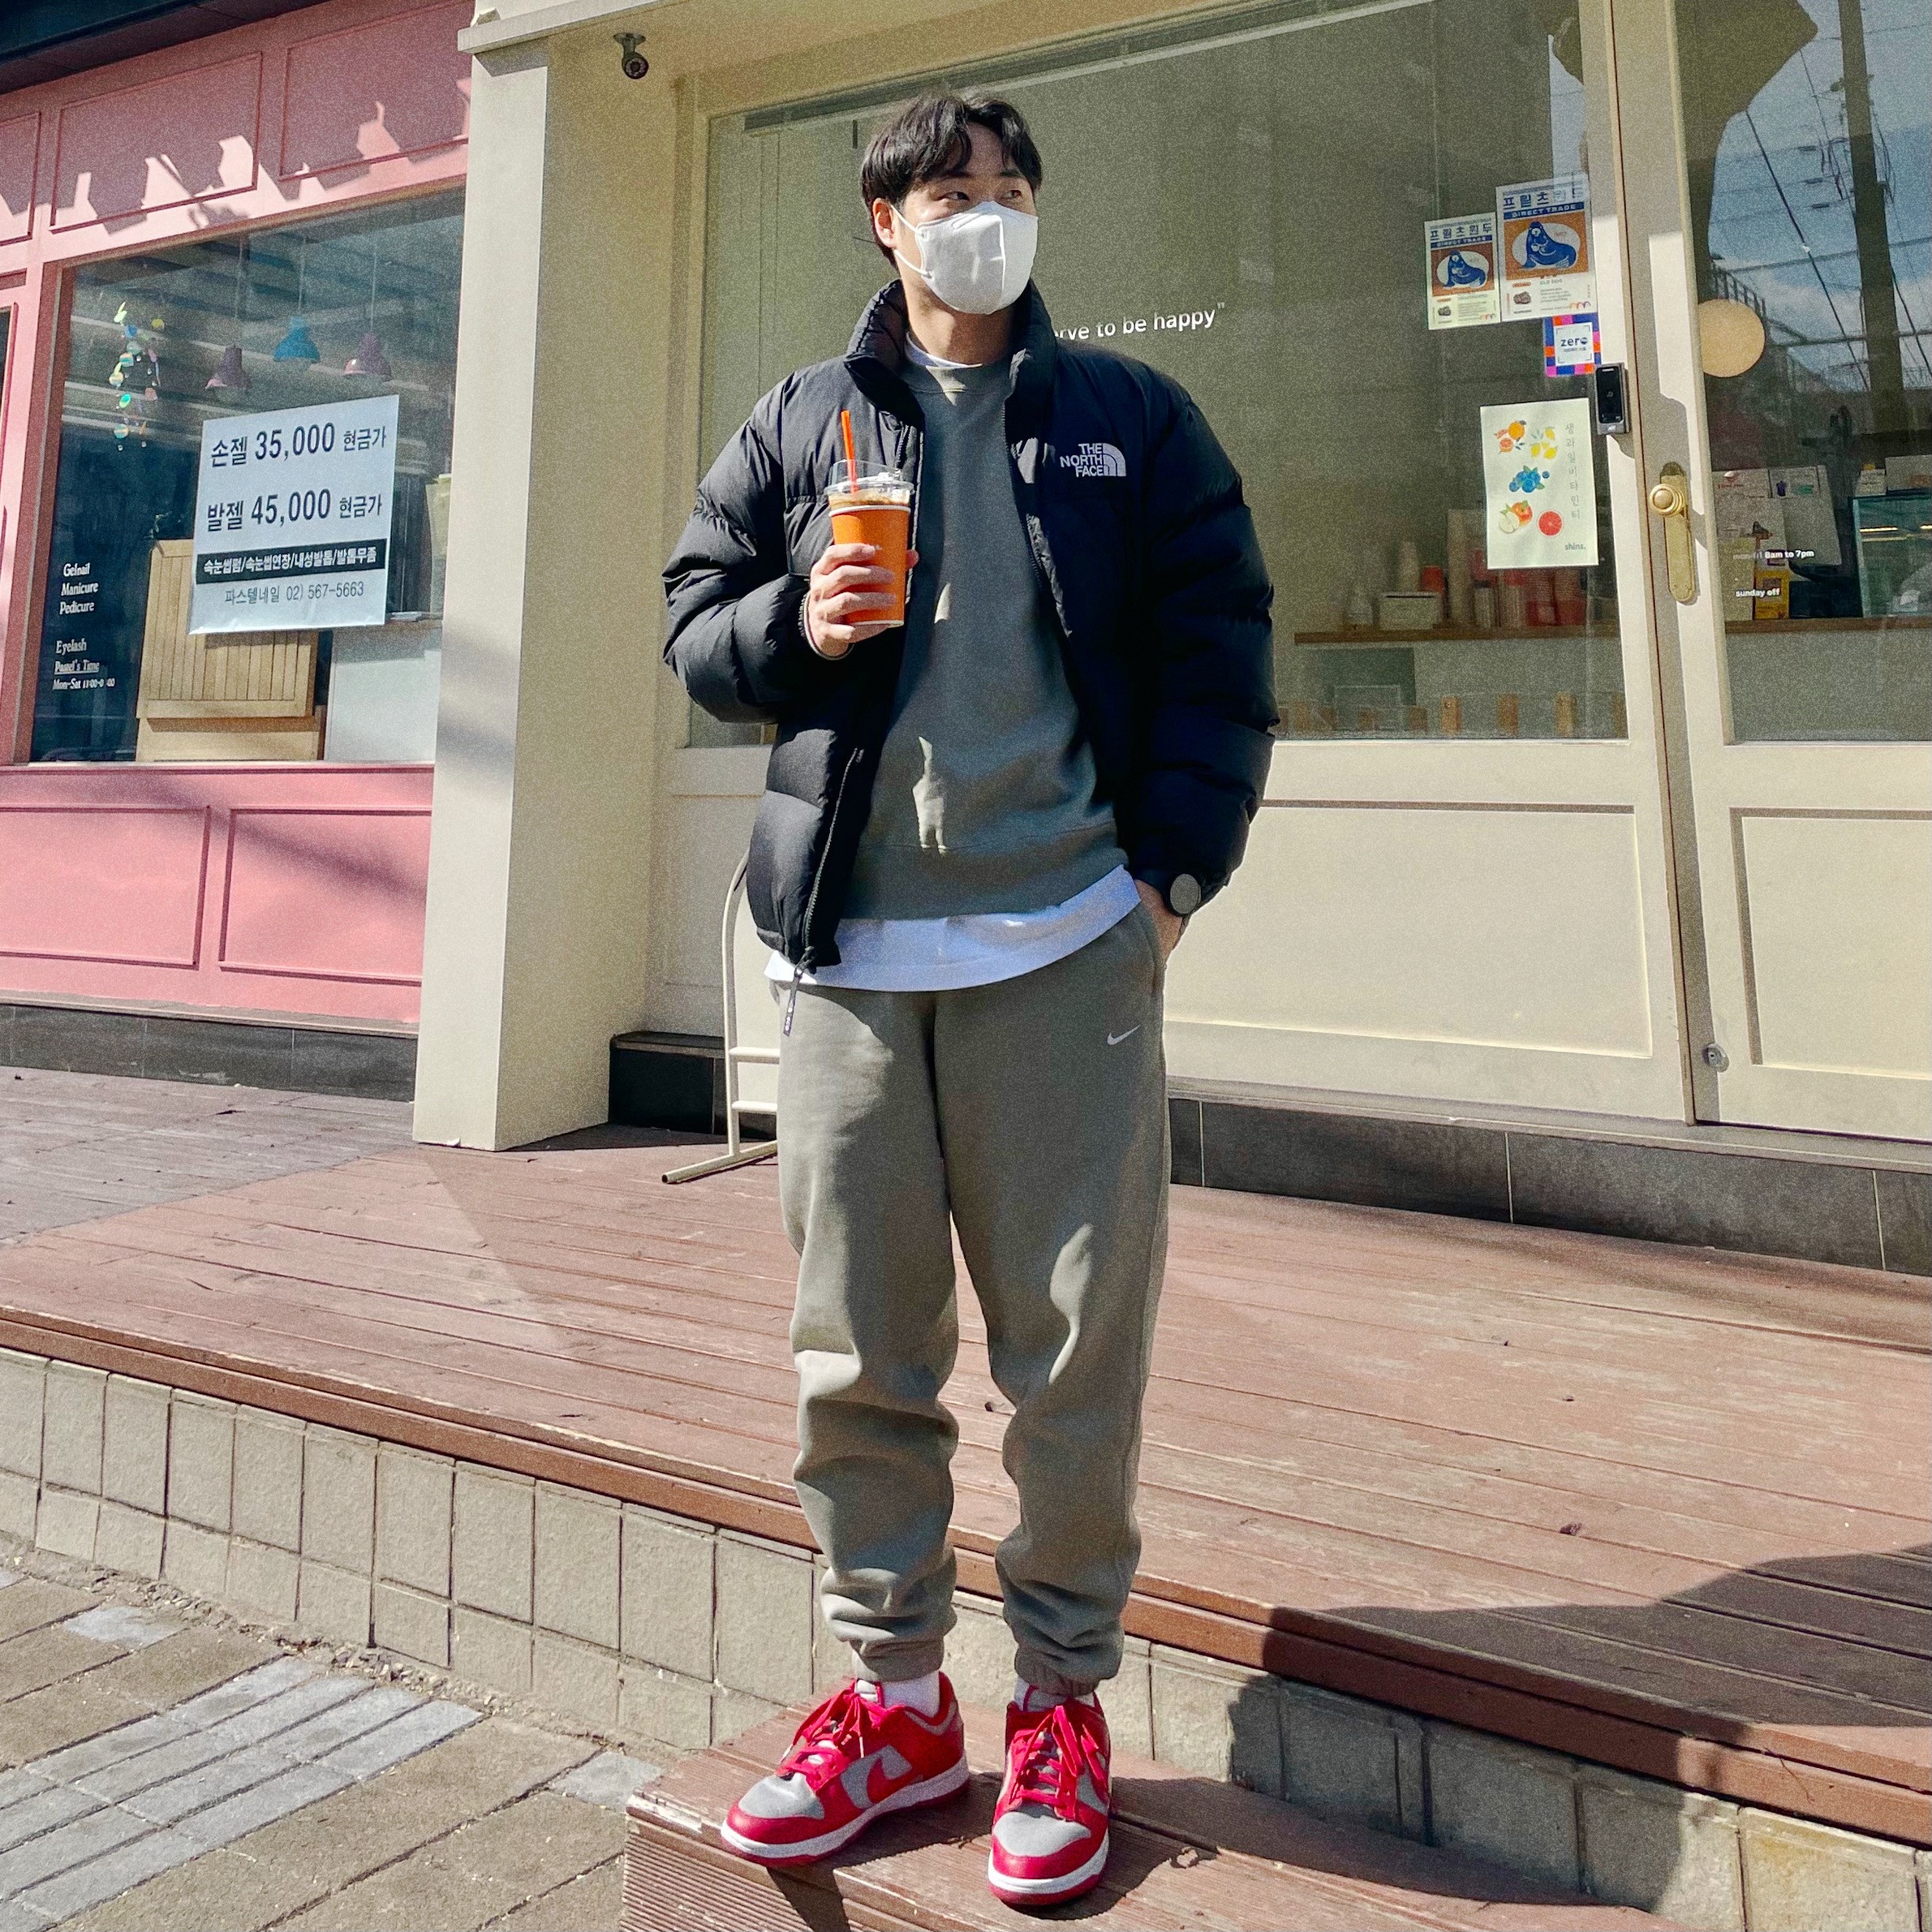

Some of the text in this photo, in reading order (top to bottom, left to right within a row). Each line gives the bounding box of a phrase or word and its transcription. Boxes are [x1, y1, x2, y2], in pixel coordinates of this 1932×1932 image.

[1512, 204, 1576, 219] DIRECT TRADE
[1096, 321, 1116, 337] to
[1123, 316, 1147, 334] be
[1560, 337, 1588, 346] zero
[211, 422, 387, 467] 손젤 35,000 현금가
[1078, 443, 1103, 454] THE
[1059, 454, 1103, 468] NORTH
[1075, 465, 1104, 477] FACE
[207, 488, 383, 532] 발젤 45,000 현금가
[1796, 550, 1815, 559] 7pm
[63, 562, 91, 577] Gelnail
[61, 582, 99, 596] Manicure
[225, 581, 364, 605] 파스텔네일 02) 567-5663
[1736, 587, 1781, 598] sunday off
[59, 600, 95, 615] Pedicure
[56, 637, 87, 656] Eyelash
[52, 678, 81, 690] Mon-Sat
